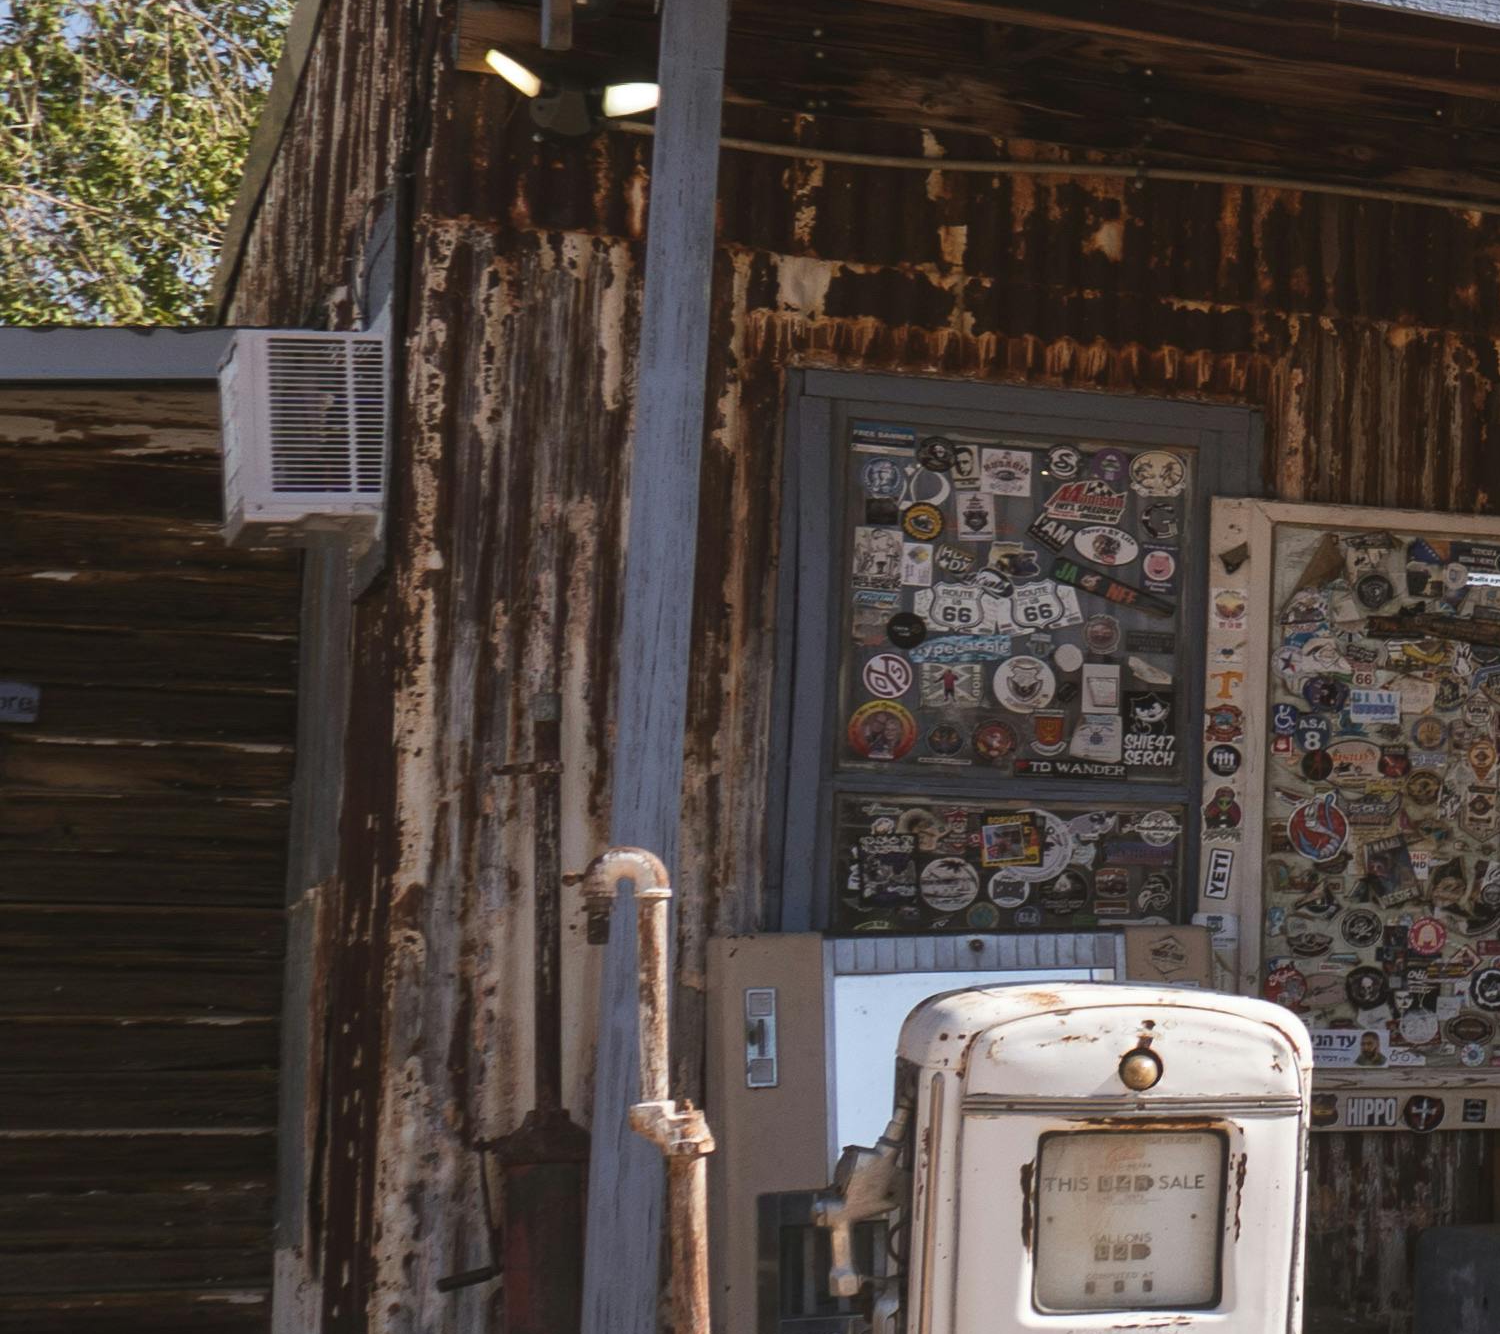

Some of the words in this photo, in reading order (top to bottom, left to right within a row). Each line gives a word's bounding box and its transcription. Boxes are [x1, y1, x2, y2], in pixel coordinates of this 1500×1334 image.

[941, 588, 976, 600] ROUTE
[1016, 586, 1049, 598] ROUTE
[942, 606, 972, 623] 66
[1024, 604, 1052, 622] 66
[1355, 675, 1372, 685] 66
[1299, 719, 1328, 730] ASA
[1304, 732, 1321, 750] 8
[1056, 762, 1126, 777] WANDER
[1209, 853, 1230, 896] YETI
[1347, 1098, 1398, 1127] HIPPO
[1044, 1177, 1089, 1192] THIS
[1158, 1174, 1206, 1190] SALE
